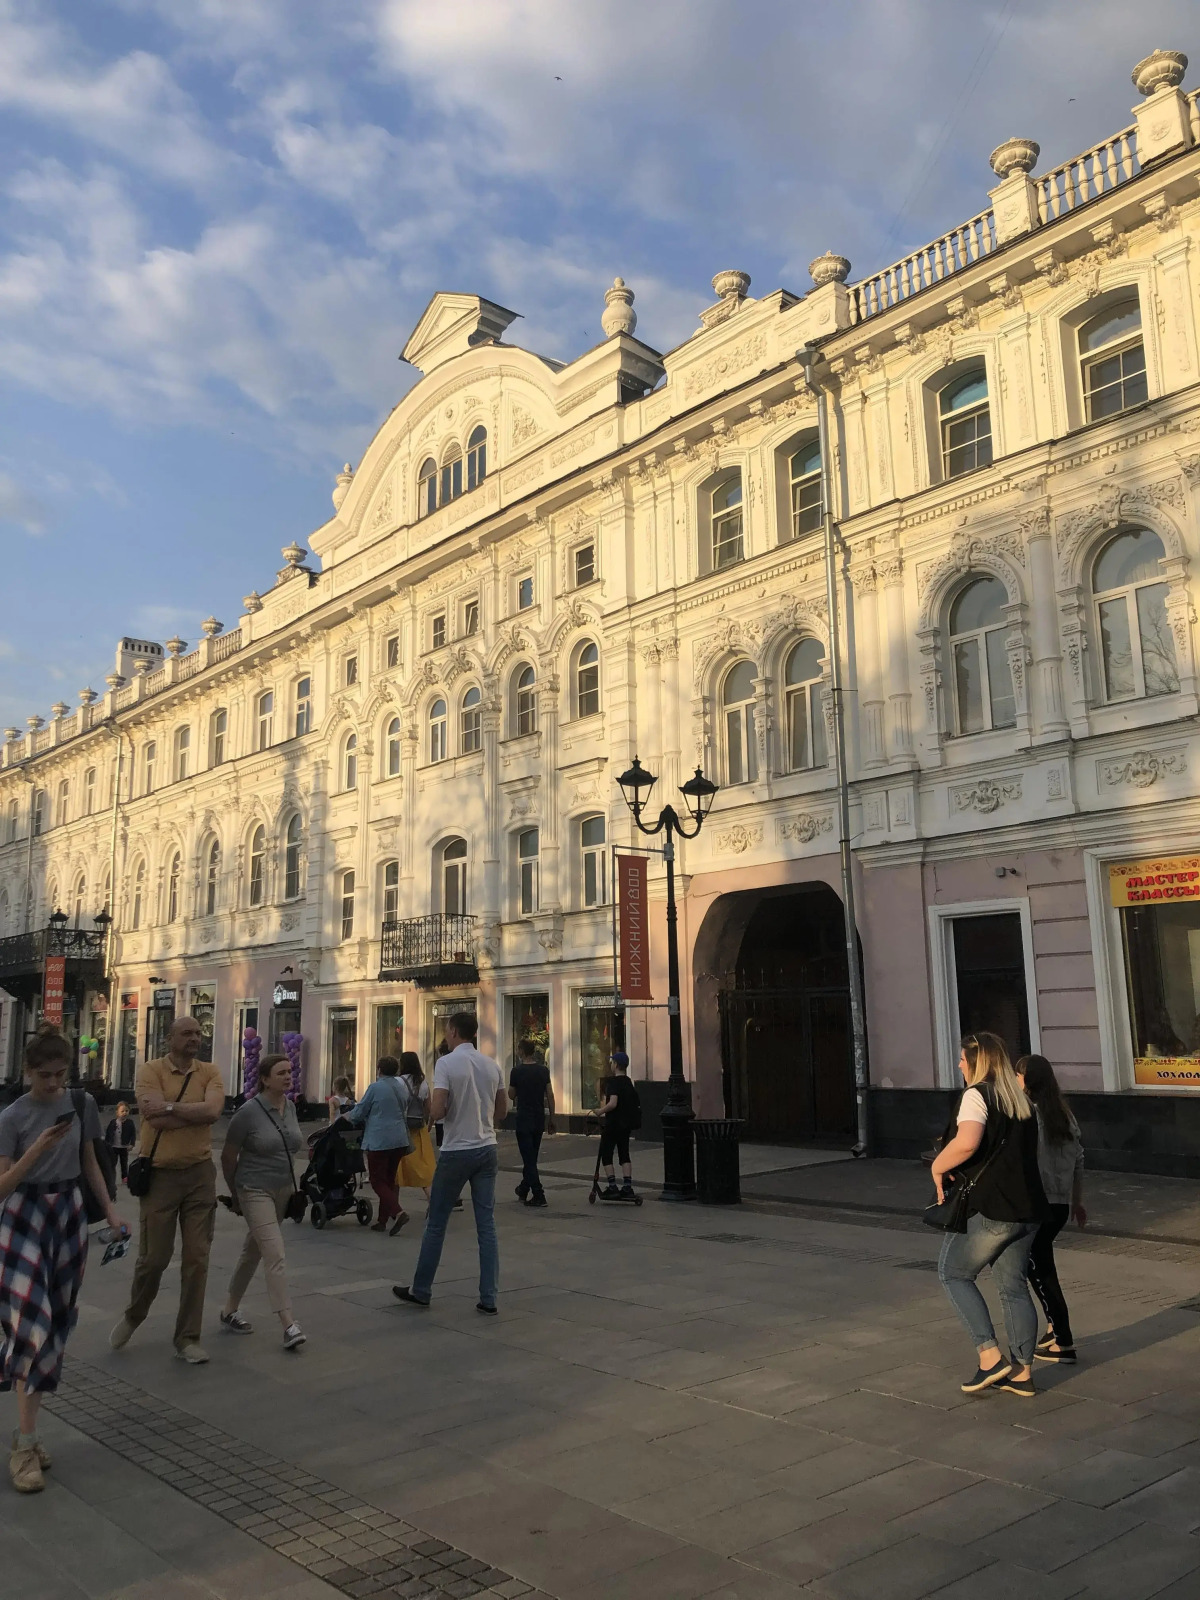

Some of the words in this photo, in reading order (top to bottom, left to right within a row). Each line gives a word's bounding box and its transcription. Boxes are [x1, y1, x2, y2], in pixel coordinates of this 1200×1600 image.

[627, 868, 640, 899] 800
[1126, 871, 1199, 888] МАСТЕР
[1127, 885, 1200, 901] КЛАССЫ
[626, 901, 641, 987] НИЖНИЙ
[282, 989, 297, 1001] Вход
